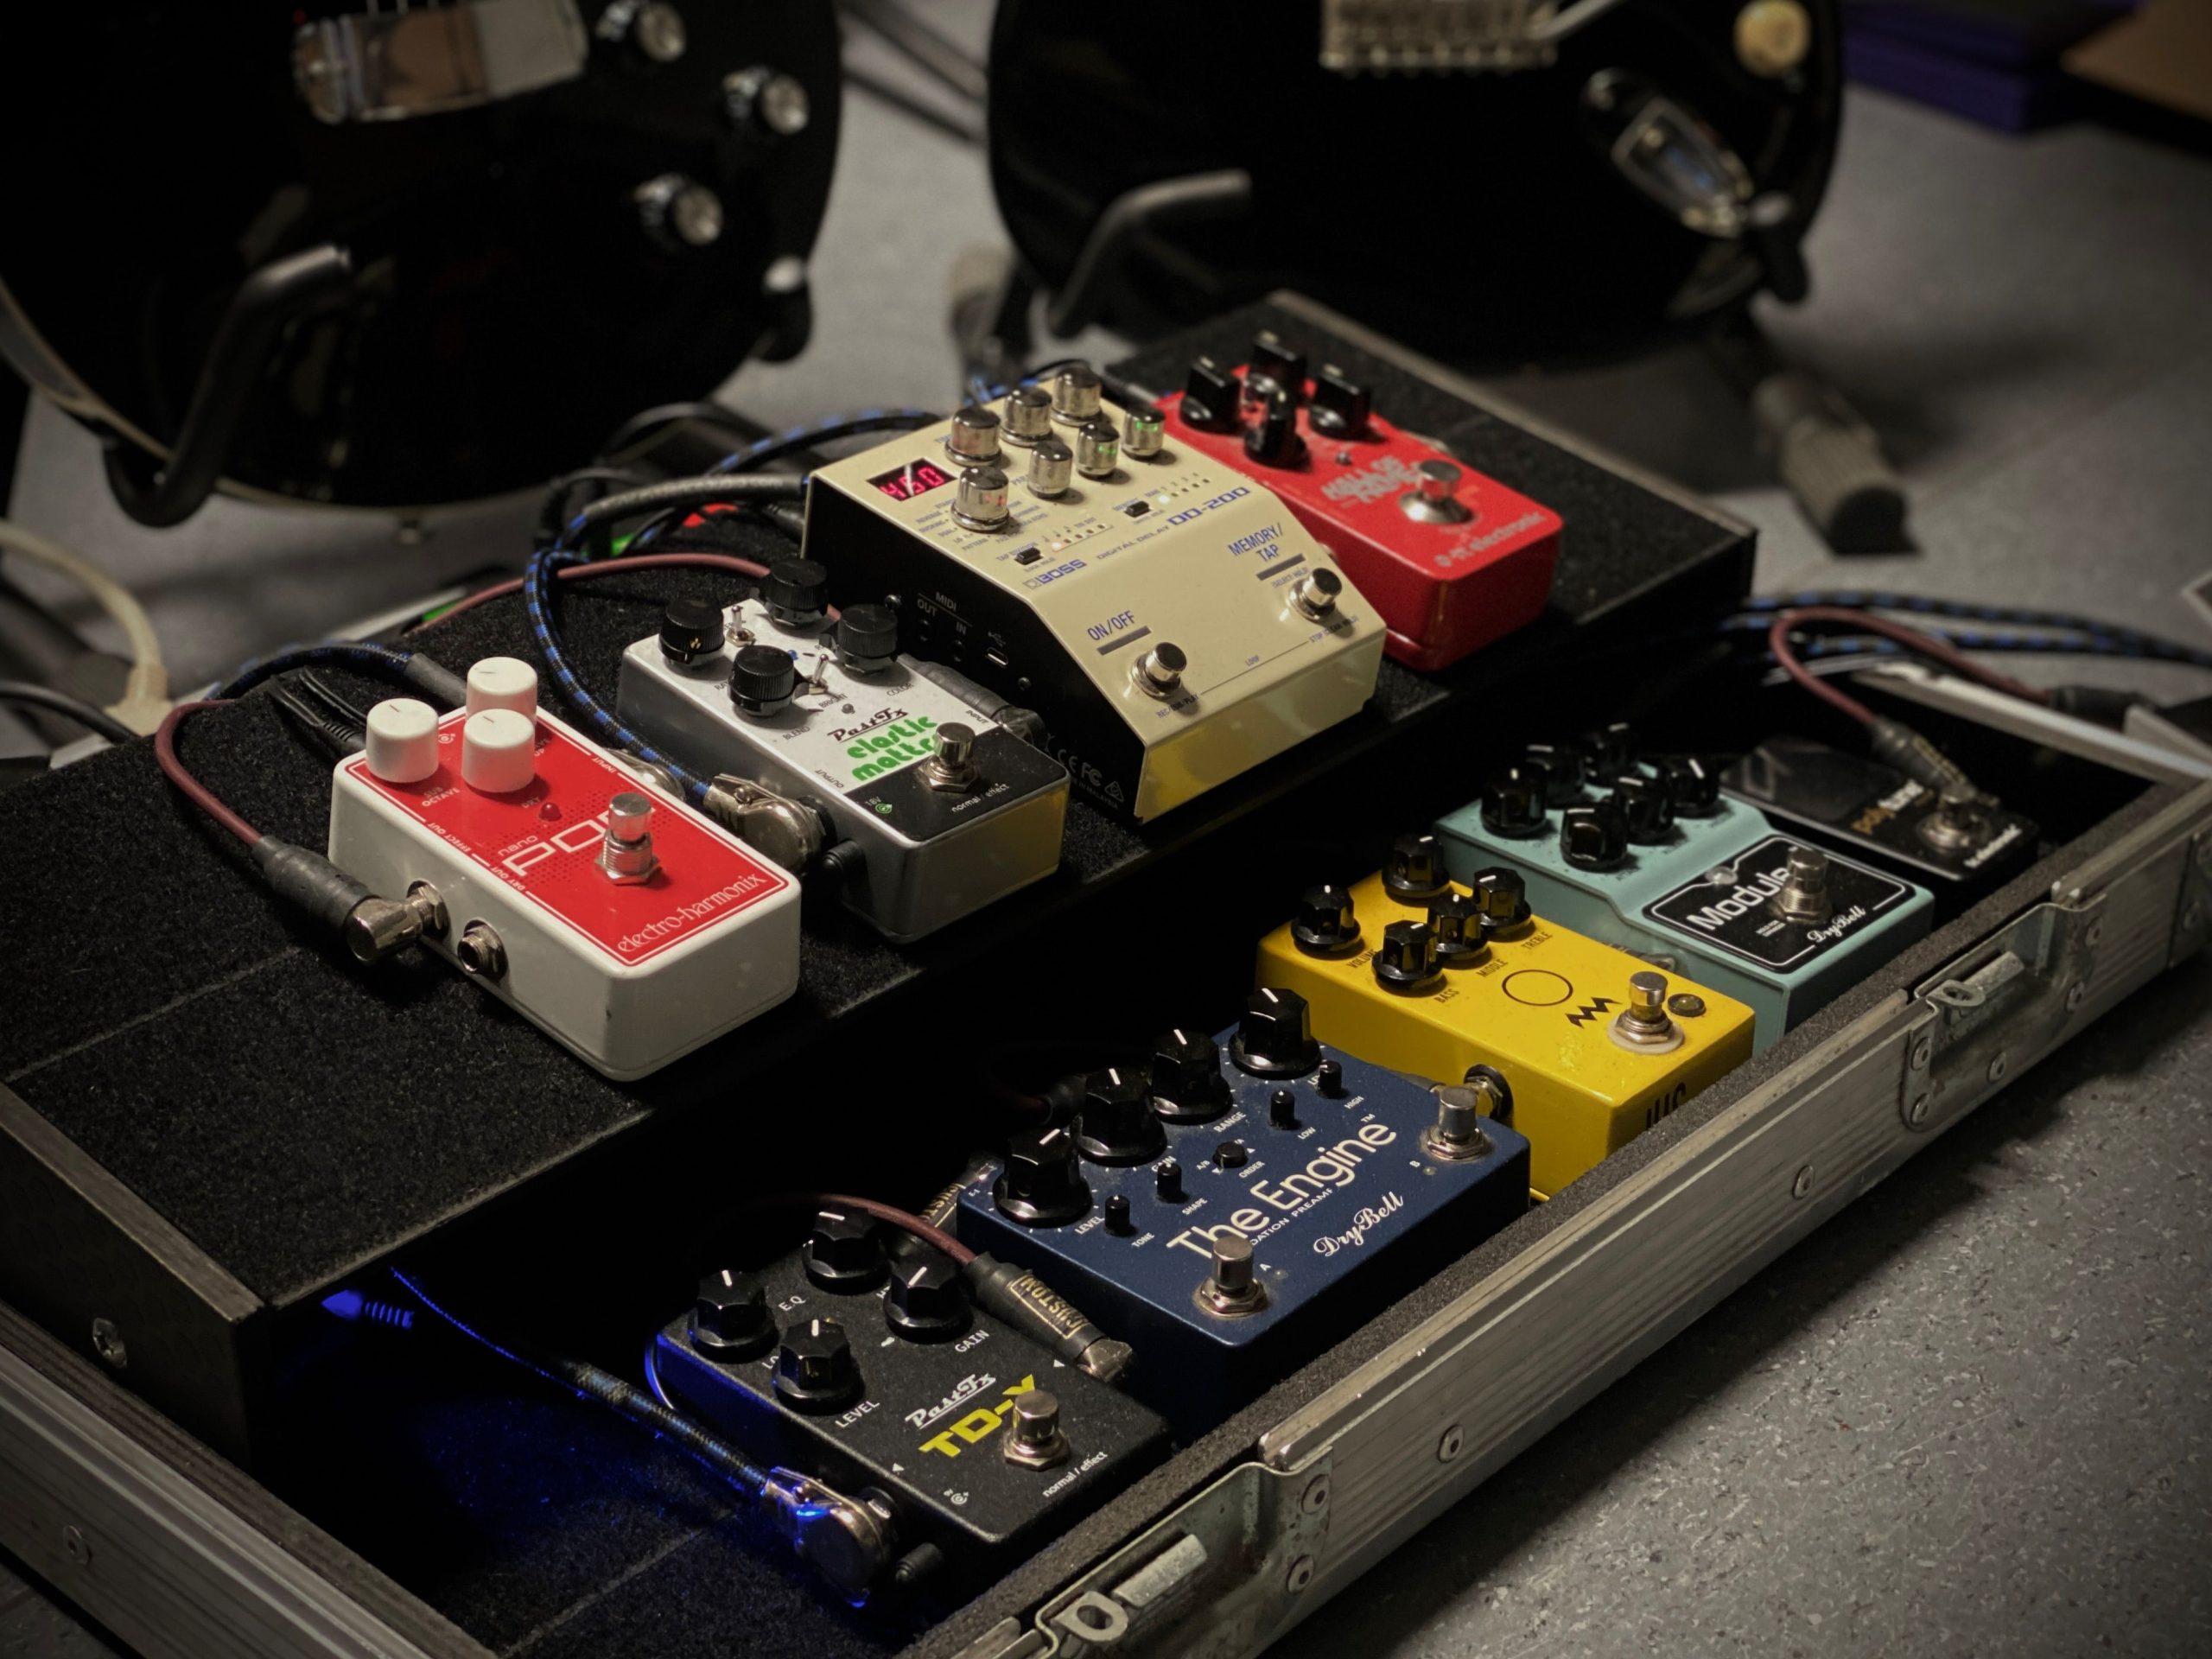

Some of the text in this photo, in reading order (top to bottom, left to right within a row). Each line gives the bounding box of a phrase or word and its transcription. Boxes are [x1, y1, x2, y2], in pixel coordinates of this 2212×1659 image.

[1096, 541, 1135, 560] DIGITAL
[1136, 525, 1170, 543] DELAY
[1167, 486, 1250, 526] DD-200
[1227, 522, 1284, 556] MEMORY/
[1255, 543, 1280, 563] TAP
[1037, 558, 1087, 585] BOSS
[917, 597, 938, 617] OUT
[935, 591, 957, 612] MIDI
[956, 621, 967, 636] IN
[1087, 610, 1136, 641] ON/OFF
[886, 682, 914, 697] COLOR
[818, 693, 849, 709] BRIGHT
[965, 709, 989, 725] INPUT
[782, 725, 810, 741] BLEND
[847, 715, 938, 759] elastic
[592, 757, 616, 774] INPUT
[815, 769, 845, 789] OUTPUT
[422, 786, 461, 808] OCTAVE
[521, 795, 541, 810] DRY
[951, 795, 981, 813] normal
[986, 782, 1009, 798] effect
[428, 822, 448, 836] OUT
[498, 835, 538, 857] nano
[490, 865, 510, 880] OUT
[617, 873, 766, 953] electro-harmonix
[1807, 905, 1866, 944] DryBell
[1521, 931, 1553, 950] TREBLE
[1476, 958, 1509, 978] MIDDLE
[1433, 988, 1459, 1004] BASS
[1344, 1095, 1364, 1109] HIGH
[1213, 1110, 1247, 1133] RANGE
[1298, 1126, 1316, 1141] LOW
[1238, 1160, 1265, 1179] ORDER
[1409, 1160, 1421, 1168] B
[1166, 1208, 1270, 1259] The
[1249, 1122, 1397, 1210] Engine
[1182, 1198, 1208, 1216] SHAPE
[1074, 1216, 1105, 1235] LEVEL
[1313, 1191, 1404, 1257] DryBell
[1131, 1232, 1156, 1248] TONE
[1259, 1262, 1272, 1272] A
[955, 1329, 990, 1353] GAIN
[835, 1400, 880, 1428] LEVEL
[1043, 1471, 1077, 1497] normal
[1080, 1451, 1108, 1472] effect
